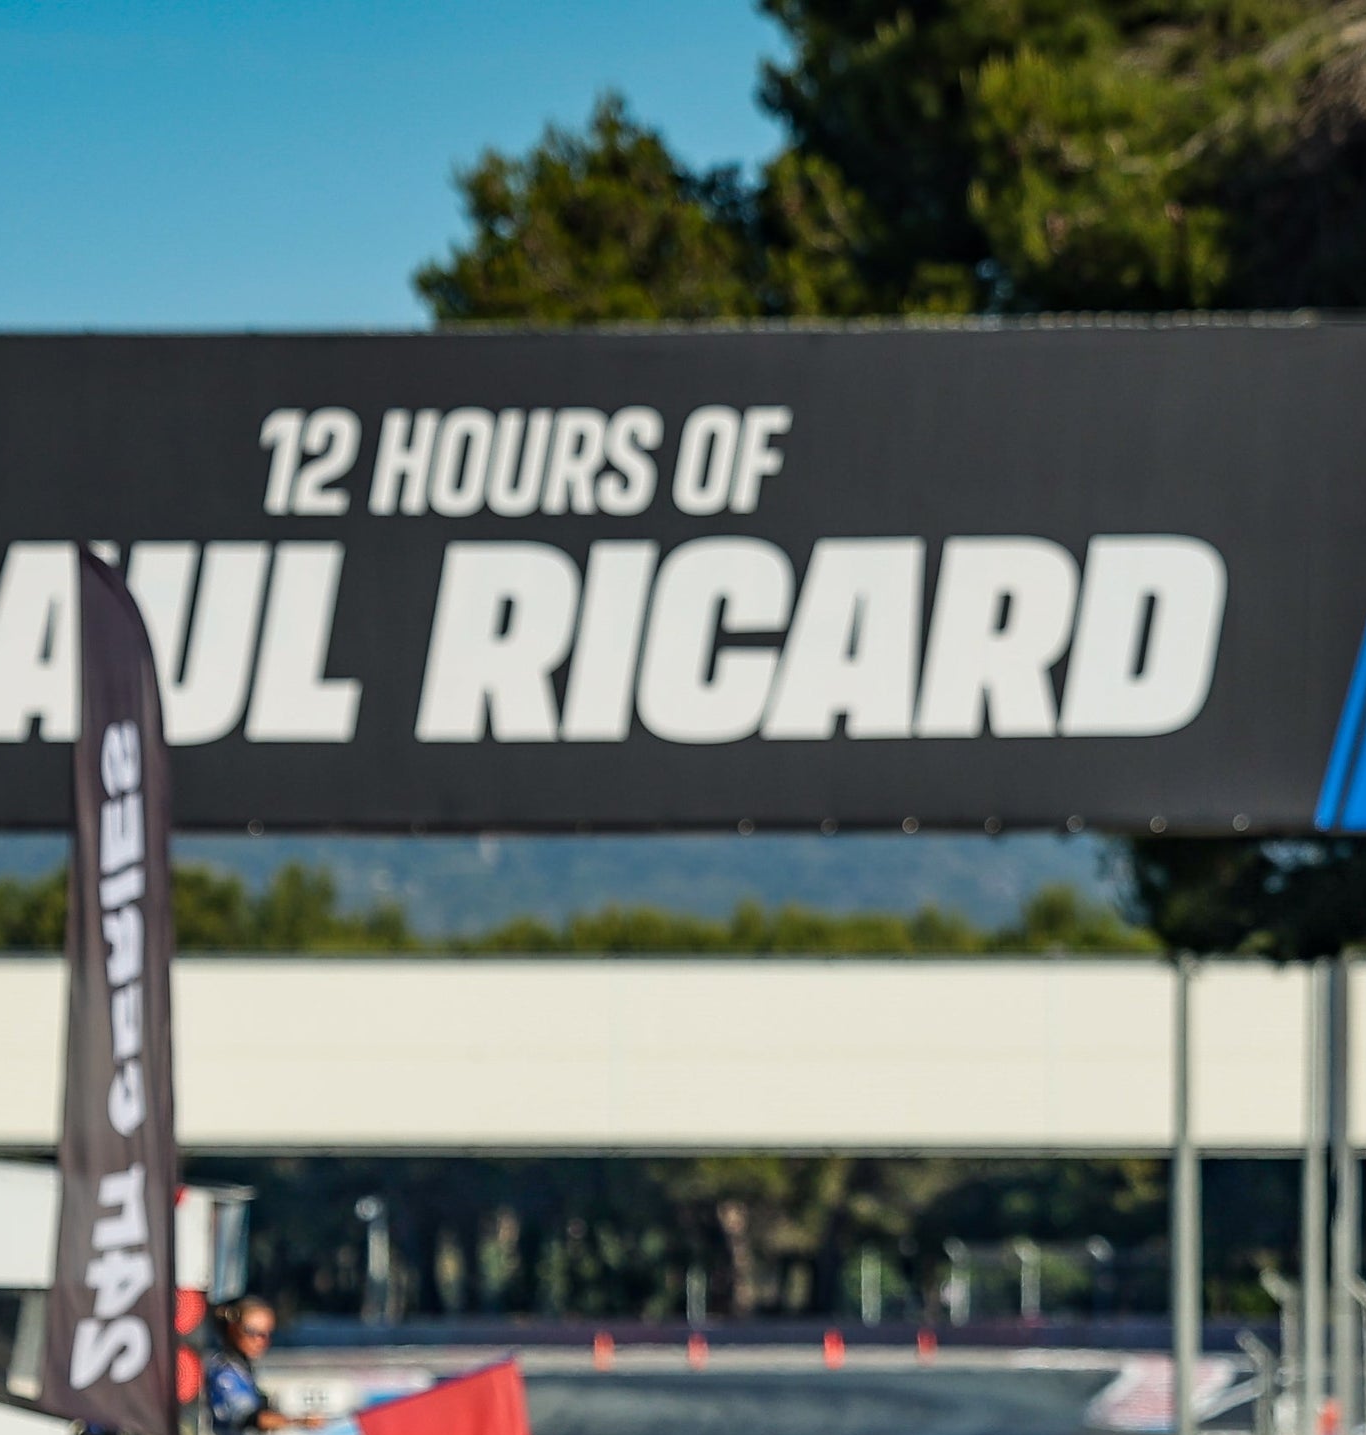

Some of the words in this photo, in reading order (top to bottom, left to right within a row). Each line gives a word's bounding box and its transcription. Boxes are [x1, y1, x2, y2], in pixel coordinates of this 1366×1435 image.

[259, 408, 363, 517] 12
[368, 406, 664, 518] HOURS
[671, 404, 793, 516] OF
[414, 533, 1229, 746] RICARD
